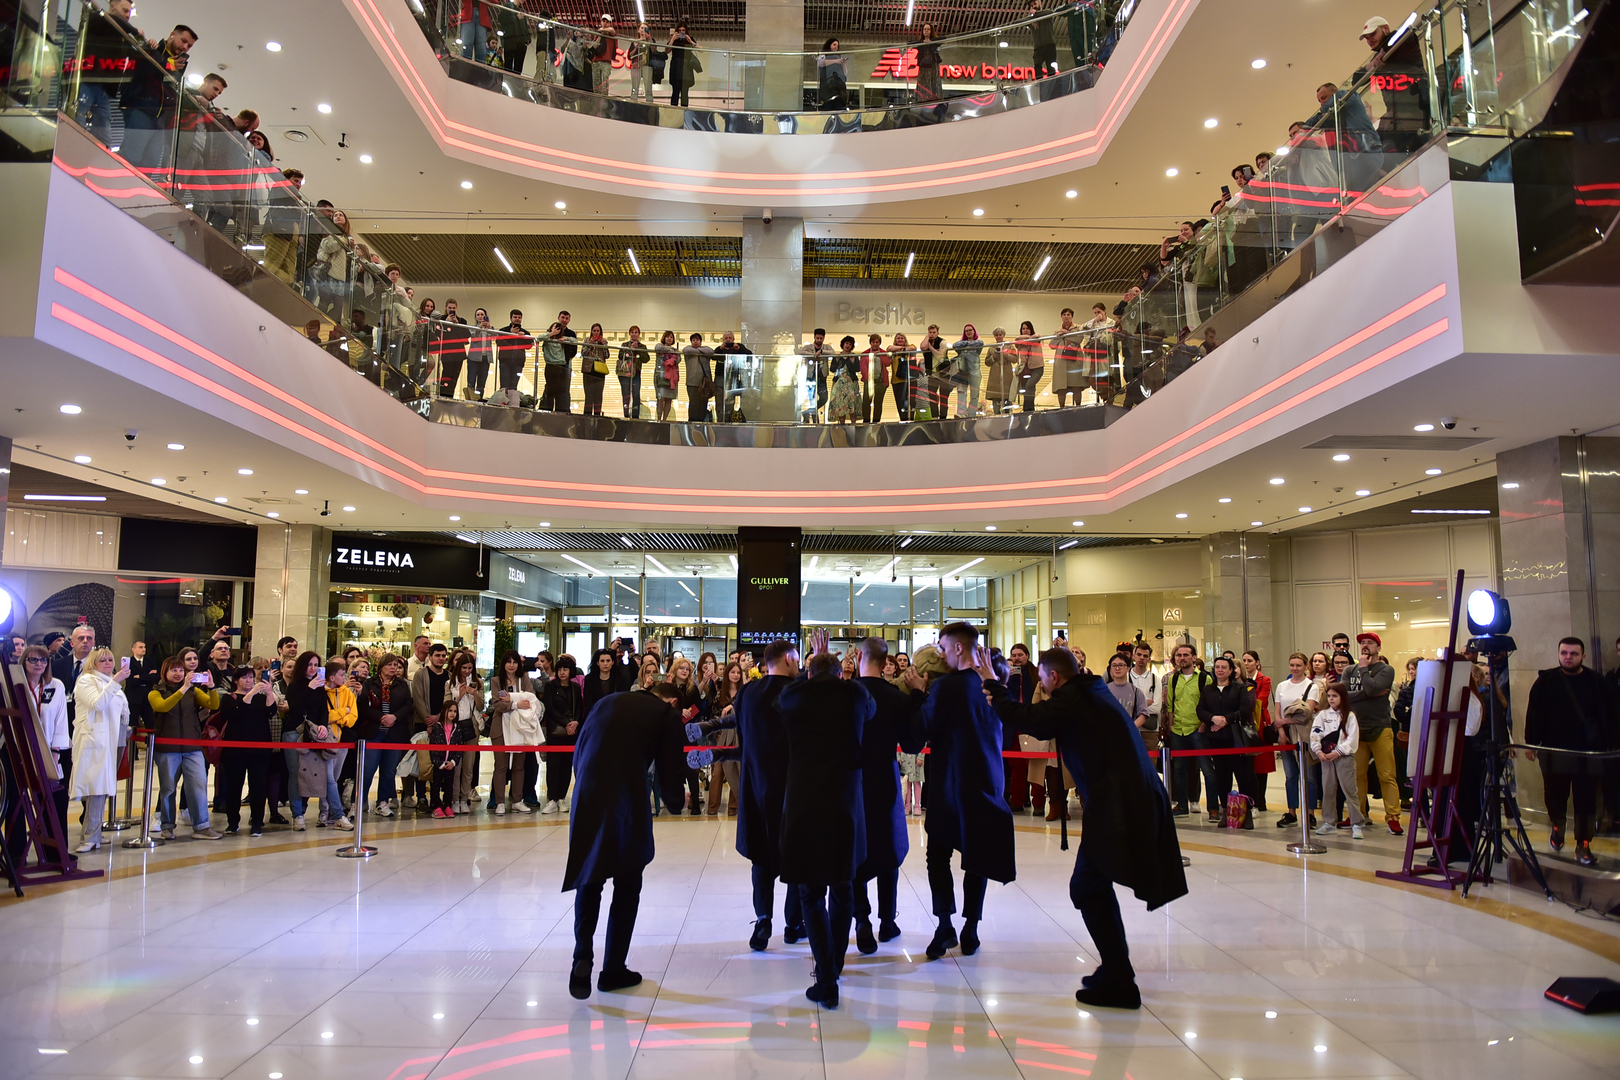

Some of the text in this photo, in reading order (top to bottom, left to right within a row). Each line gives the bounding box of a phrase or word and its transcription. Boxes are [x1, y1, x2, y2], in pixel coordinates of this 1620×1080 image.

[939, 62, 1060, 80] new balan
[838, 302, 925, 325] Bershka
[336, 547, 414, 568] ZELENA
[508, 566, 526, 584] ZELENA
[750, 577, 789, 585] GULLIVER
[1350, 677, 1361, 685] UN
